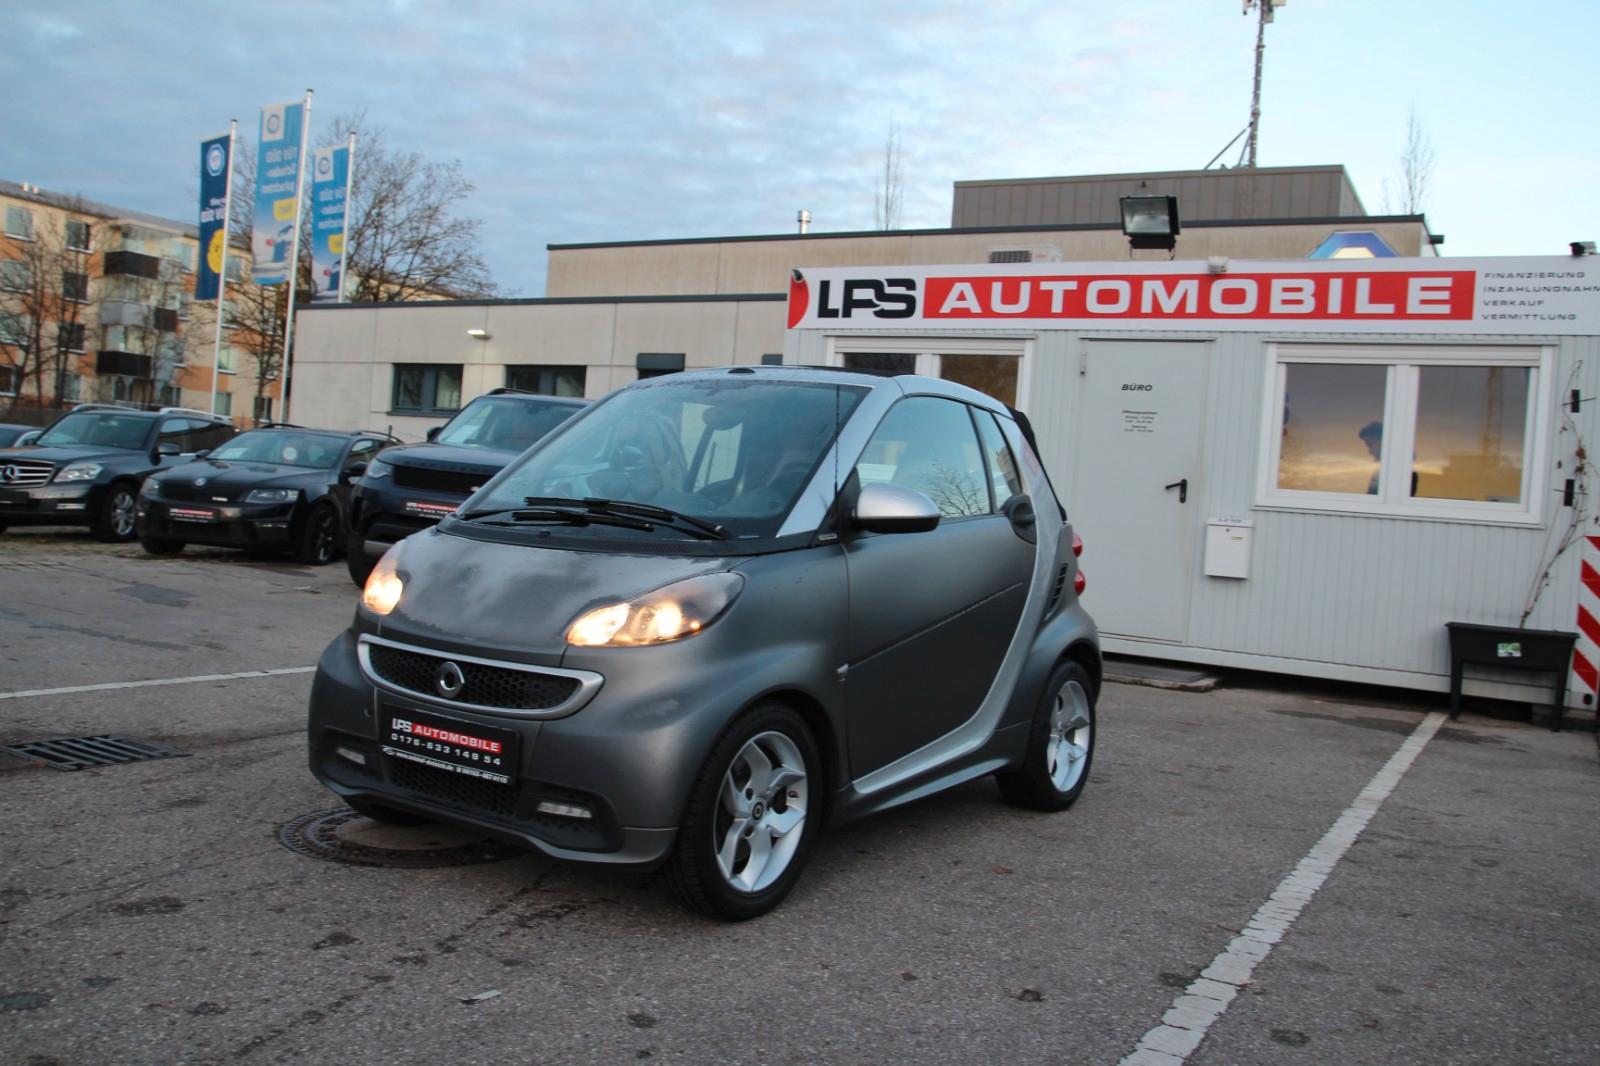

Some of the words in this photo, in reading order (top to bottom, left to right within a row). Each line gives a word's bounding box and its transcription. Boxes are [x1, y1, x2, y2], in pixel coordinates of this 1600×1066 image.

[1484, 271, 1586, 279] FINANZIERUNG
[818, 278, 917, 319] LPS
[938, 276, 1454, 316] AUTOMOBILE
[1482, 313, 1577, 321] VERMITTLUNG
[1121, 382, 1153, 392] BÜRO
[391, 718, 412, 732] LPS
[413, 725, 500, 753] AUTOMOBILE
